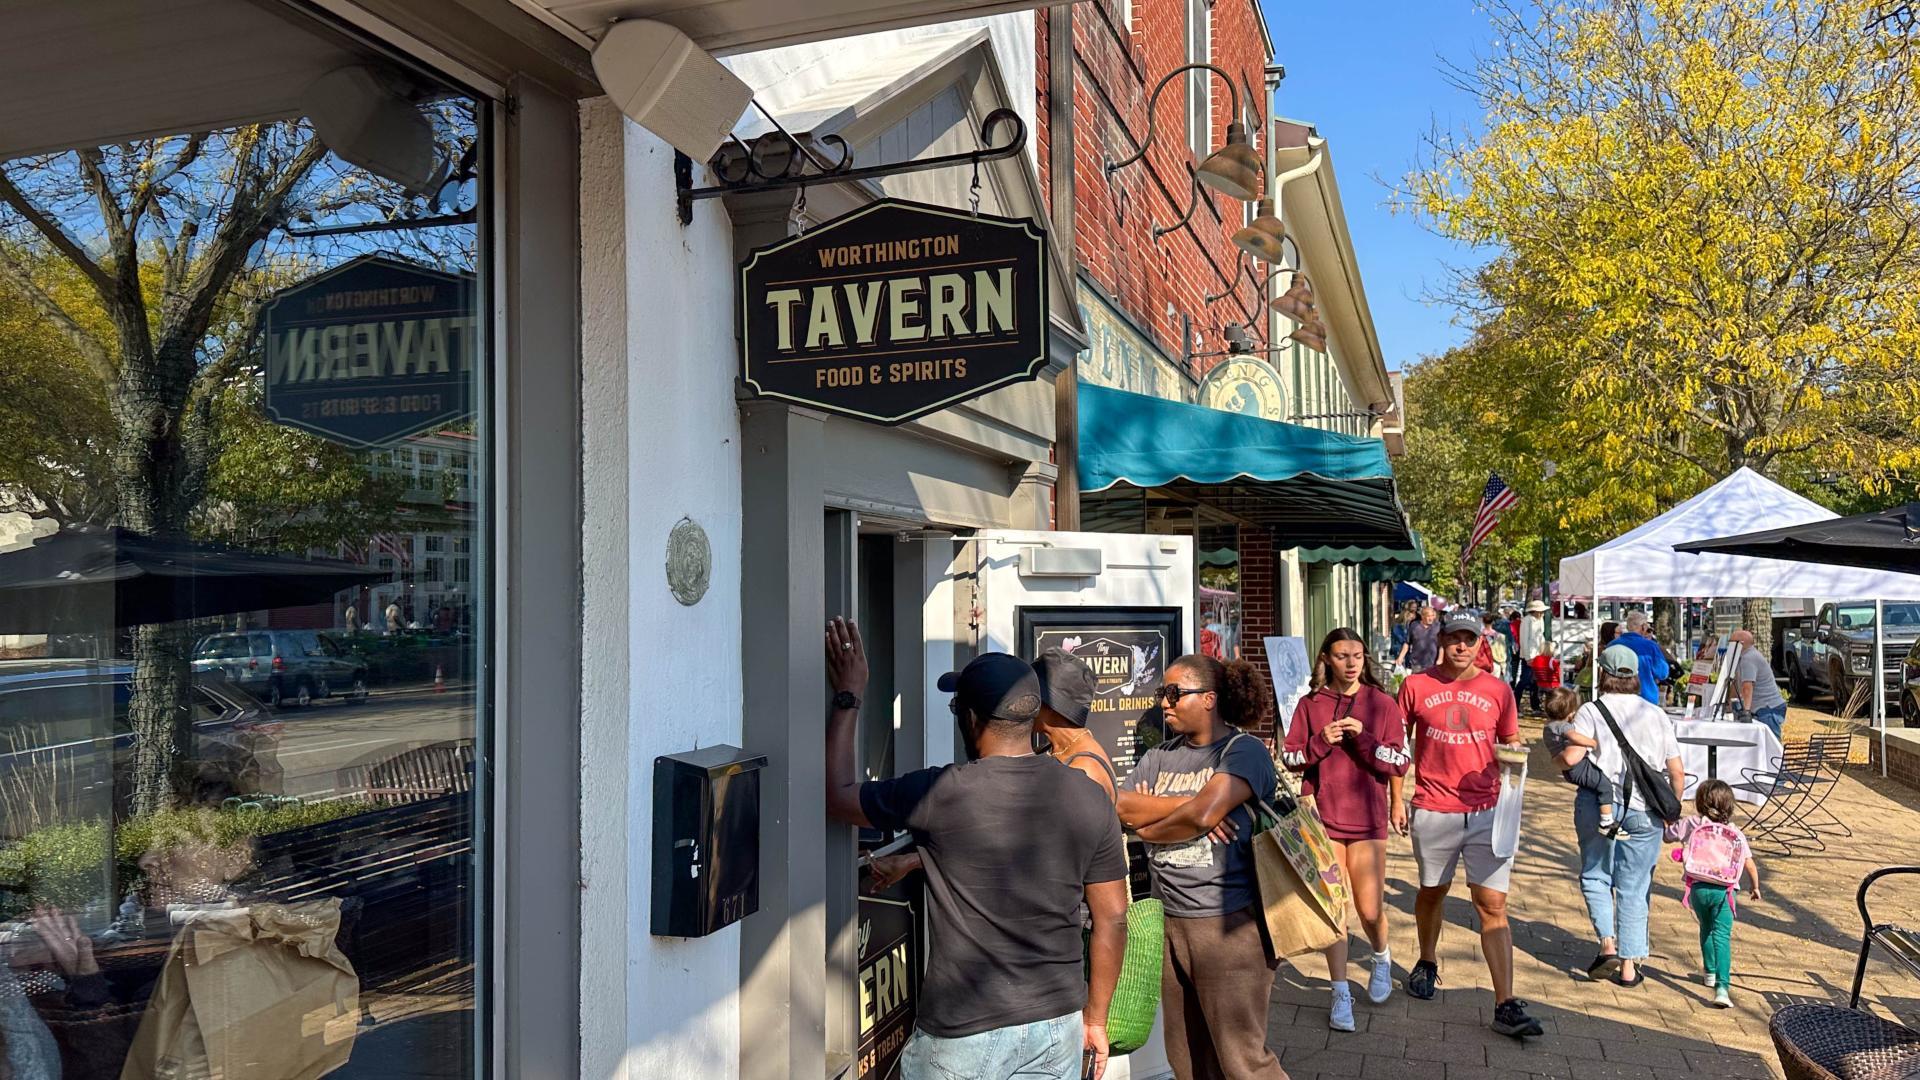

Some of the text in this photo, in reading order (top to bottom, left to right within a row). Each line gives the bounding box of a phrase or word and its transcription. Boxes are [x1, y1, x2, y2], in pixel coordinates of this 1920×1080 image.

[818, 235, 960, 269] WORTHINGTON
[766, 267, 1015, 351] TAVERN
[816, 358, 968, 389] FOOD & SPIRITS
[1096, 641, 1110, 656] Tiny
[1080, 656, 1129, 674] AVERN
[1119, 697, 1155, 711] DRINKS
[1425, 691, 1492, 712] OHIO STATE
[722, 893, 745, 925] 671
[877, 1025, 905, 1063] TREATS
